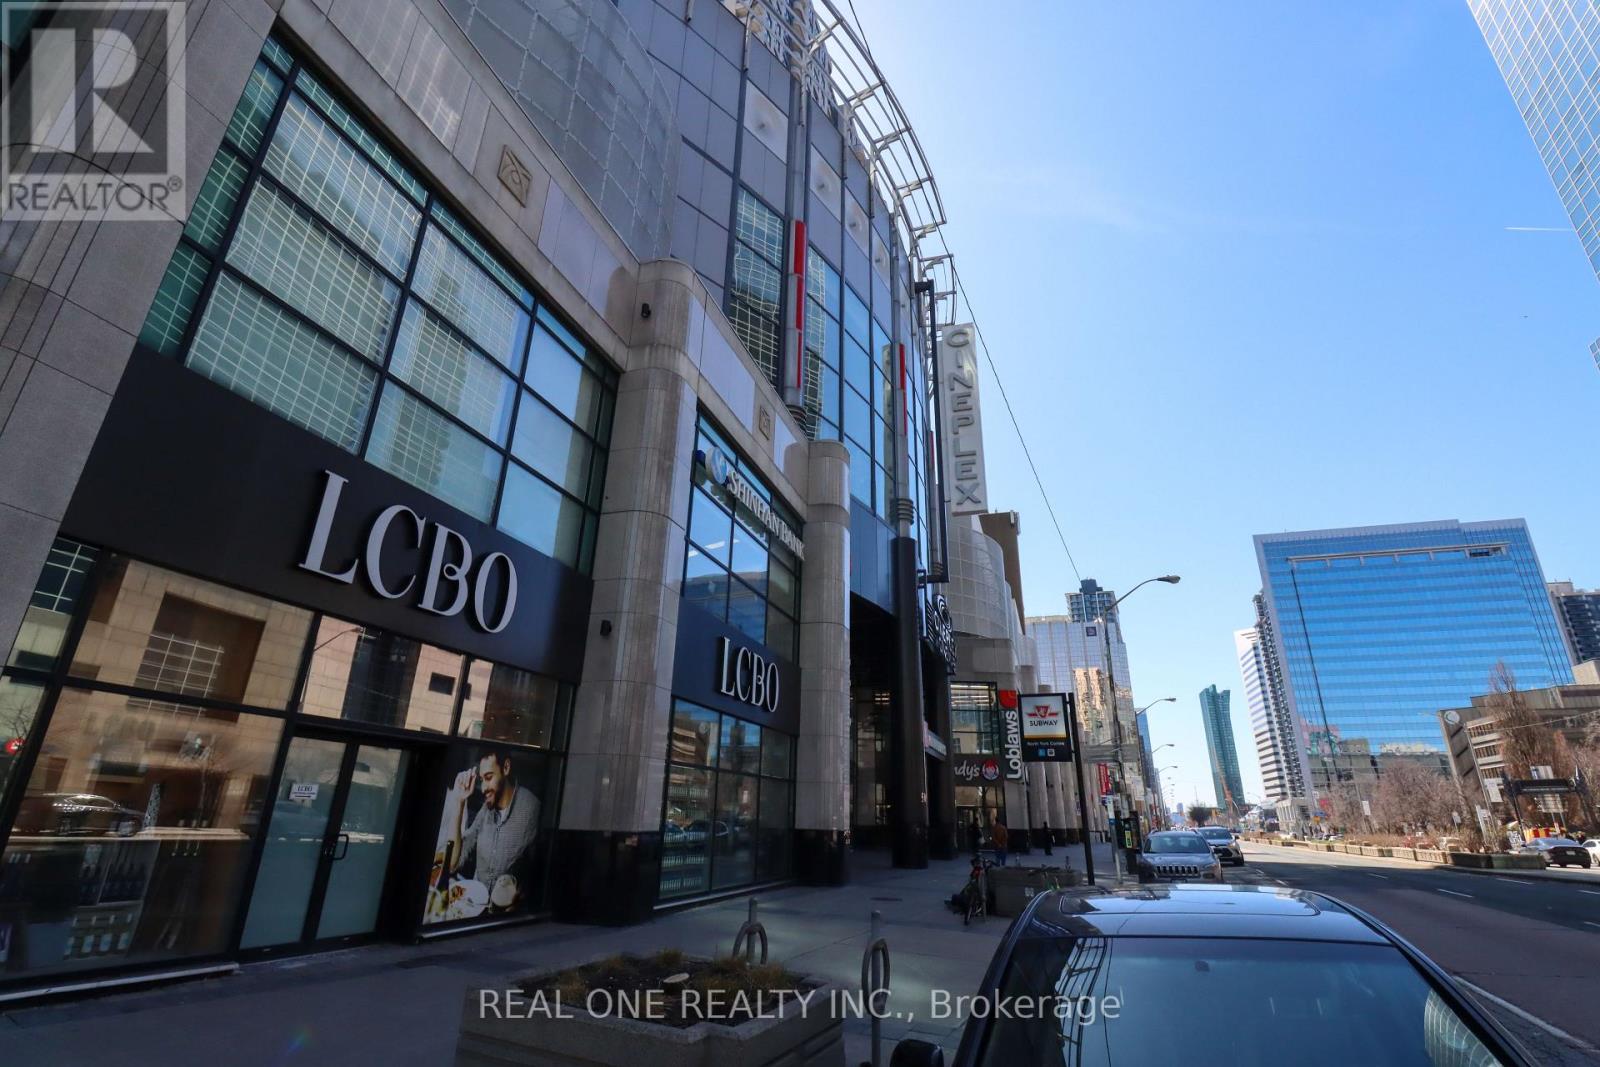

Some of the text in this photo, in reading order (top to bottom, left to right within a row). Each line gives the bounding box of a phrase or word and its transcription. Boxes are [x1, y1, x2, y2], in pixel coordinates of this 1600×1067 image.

[946, 329, 982, 506] CINEPLEX
[728, 470, 780, 537] SHINHAN
[298, 469, 518, 634] LCBO
[720, 636, 780, 713] LCBO
[1004, 710, 1023, 779] Loblaws
